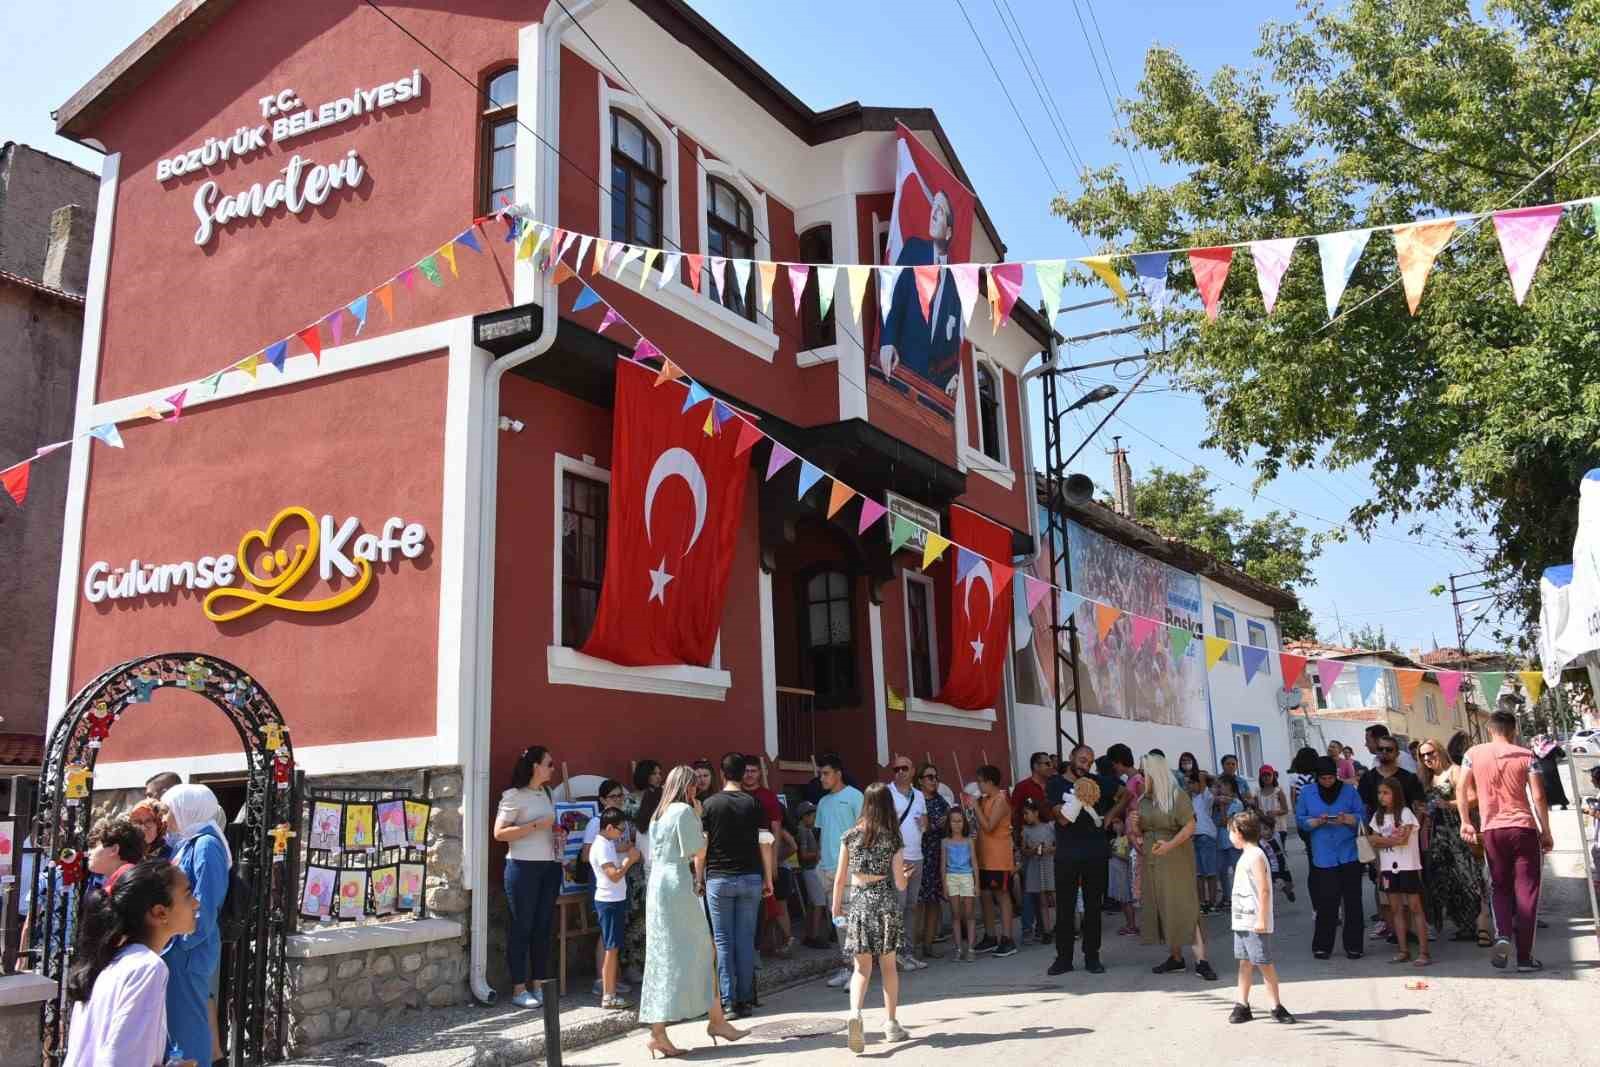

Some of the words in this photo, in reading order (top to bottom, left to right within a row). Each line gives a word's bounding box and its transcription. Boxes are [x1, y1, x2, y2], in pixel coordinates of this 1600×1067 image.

[156, 126, 268, 182] BOZÜYÜK
[272, 69, 422, 142] BELEDİYESİ
[259, 88, 302, 118] T.C.
[193, 149, 364, 245] Sanatevi
[84, 553, 238, 603] Gülümse
[319, 514, 426, 580] Kafe
